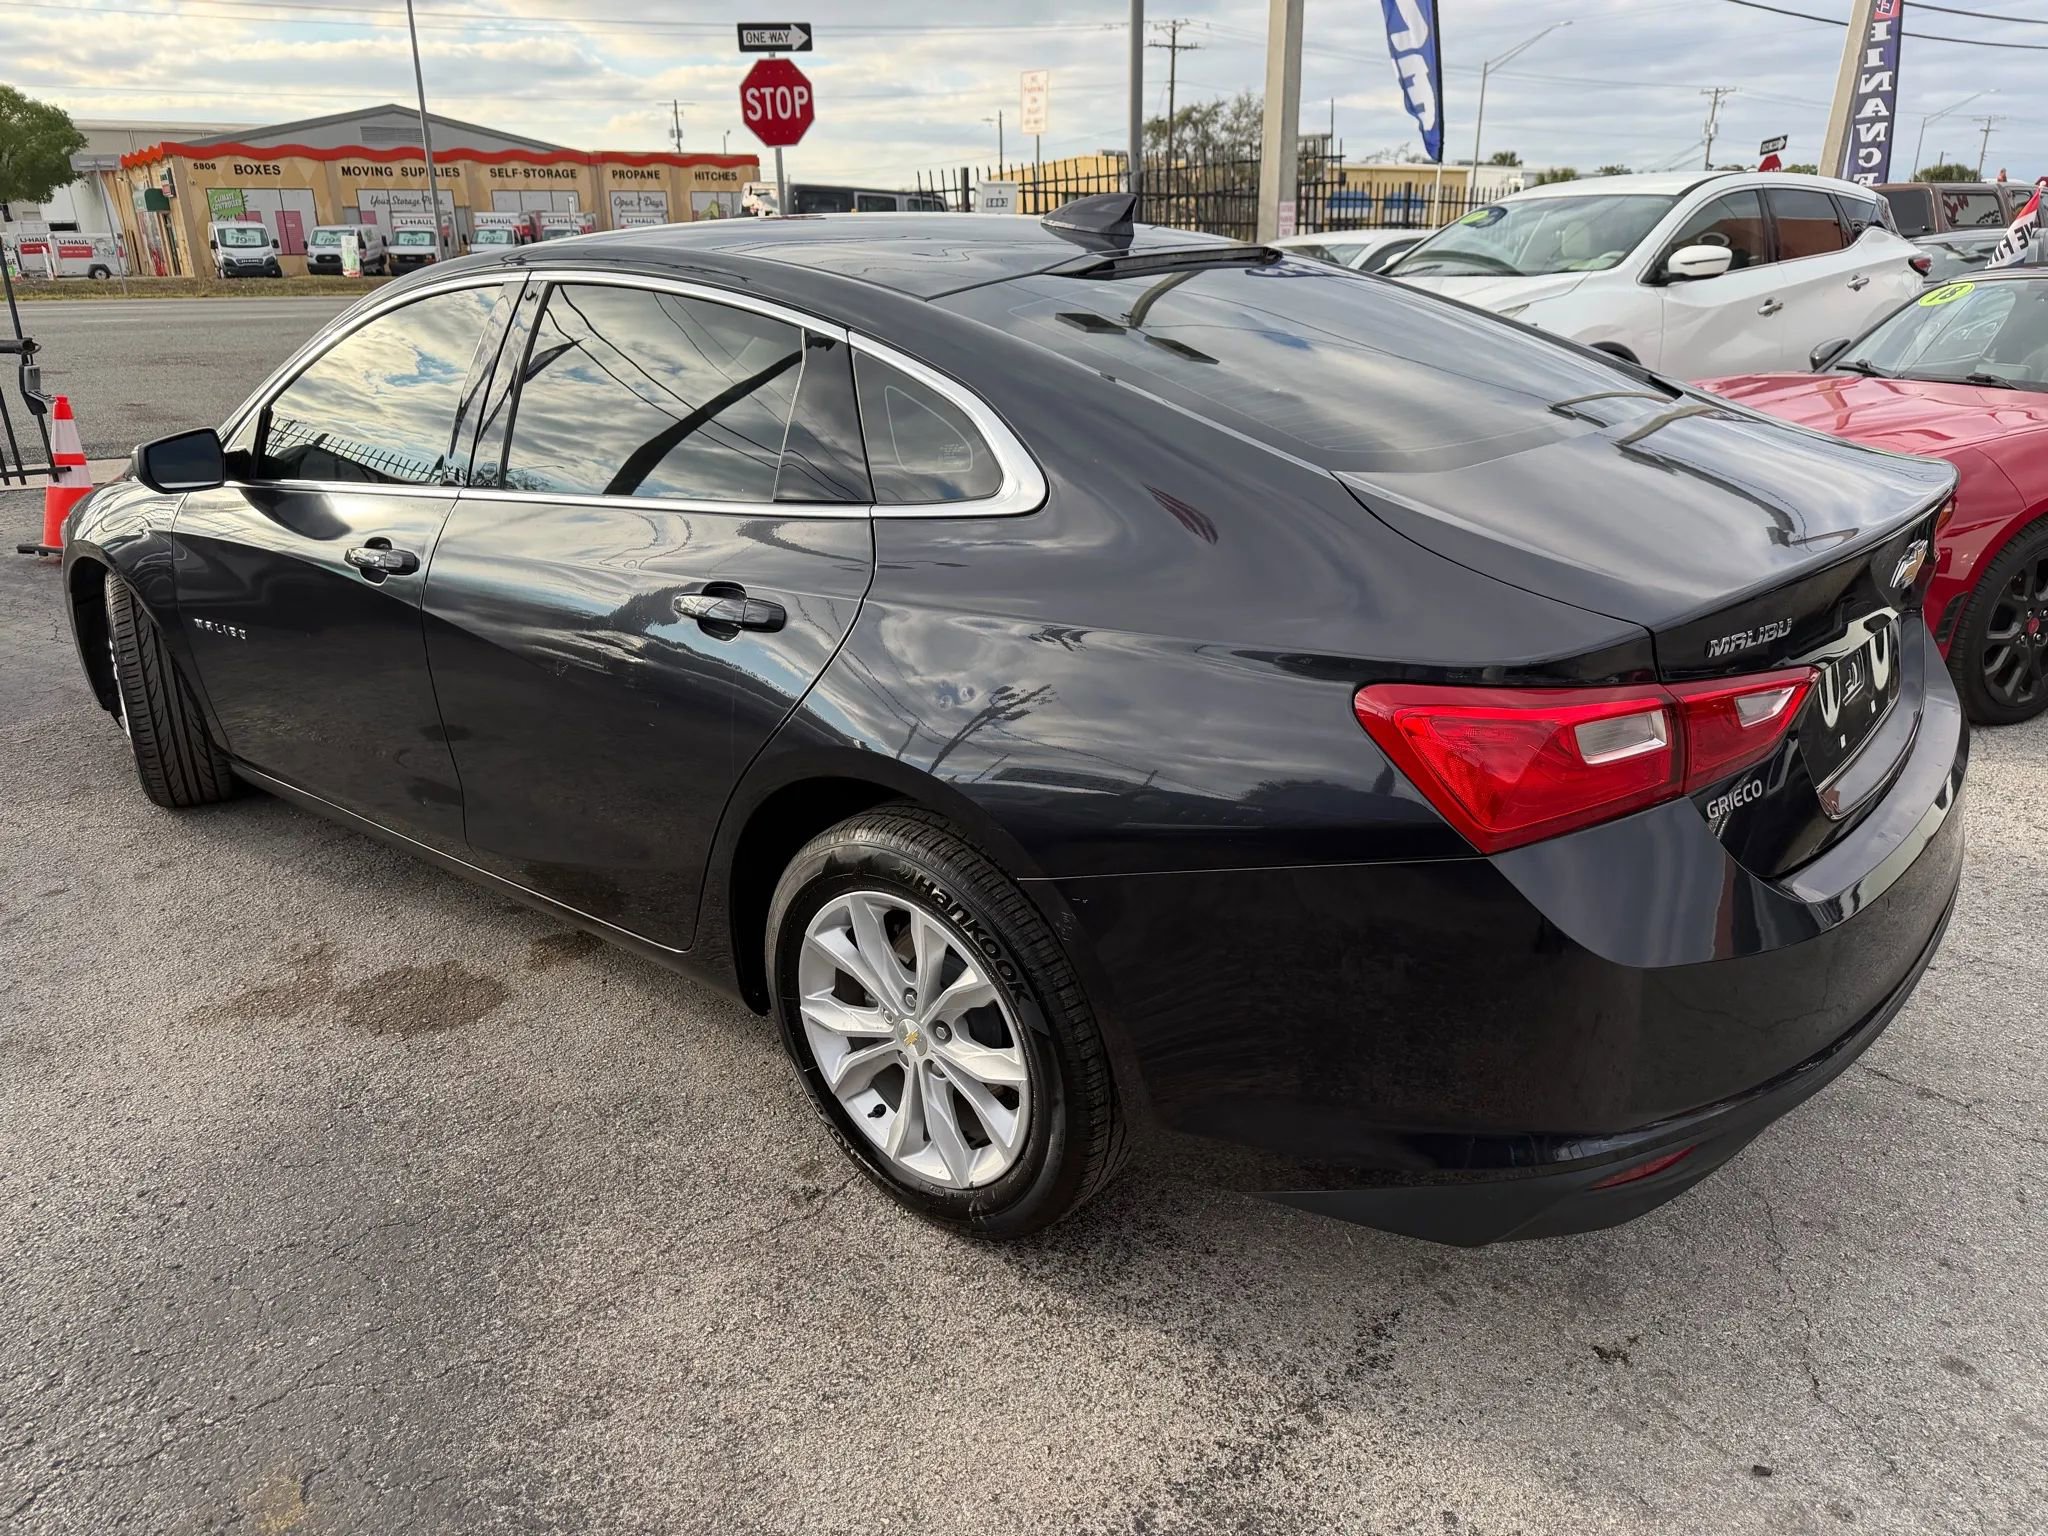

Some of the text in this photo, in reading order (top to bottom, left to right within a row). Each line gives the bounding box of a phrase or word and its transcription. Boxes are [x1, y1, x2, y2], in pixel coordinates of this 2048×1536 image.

[745, 31, 790, 43] ONE WAY
[745, 85, 809, 121] STOP
[193, 162, 216, 170] 5806
[234, 164, 281, 176] BOXES
[341, 166, 460, 178] MOVING SUPLIES
[612, 169, 660, 180] PROPANE
[695, 171, 737, 182] HITCHES
[1706, 617, 1793, 658] MALIBU
[1706, 778, 1763, 819] GRIECO
[913, 873, 1032, 1005] Hankook
